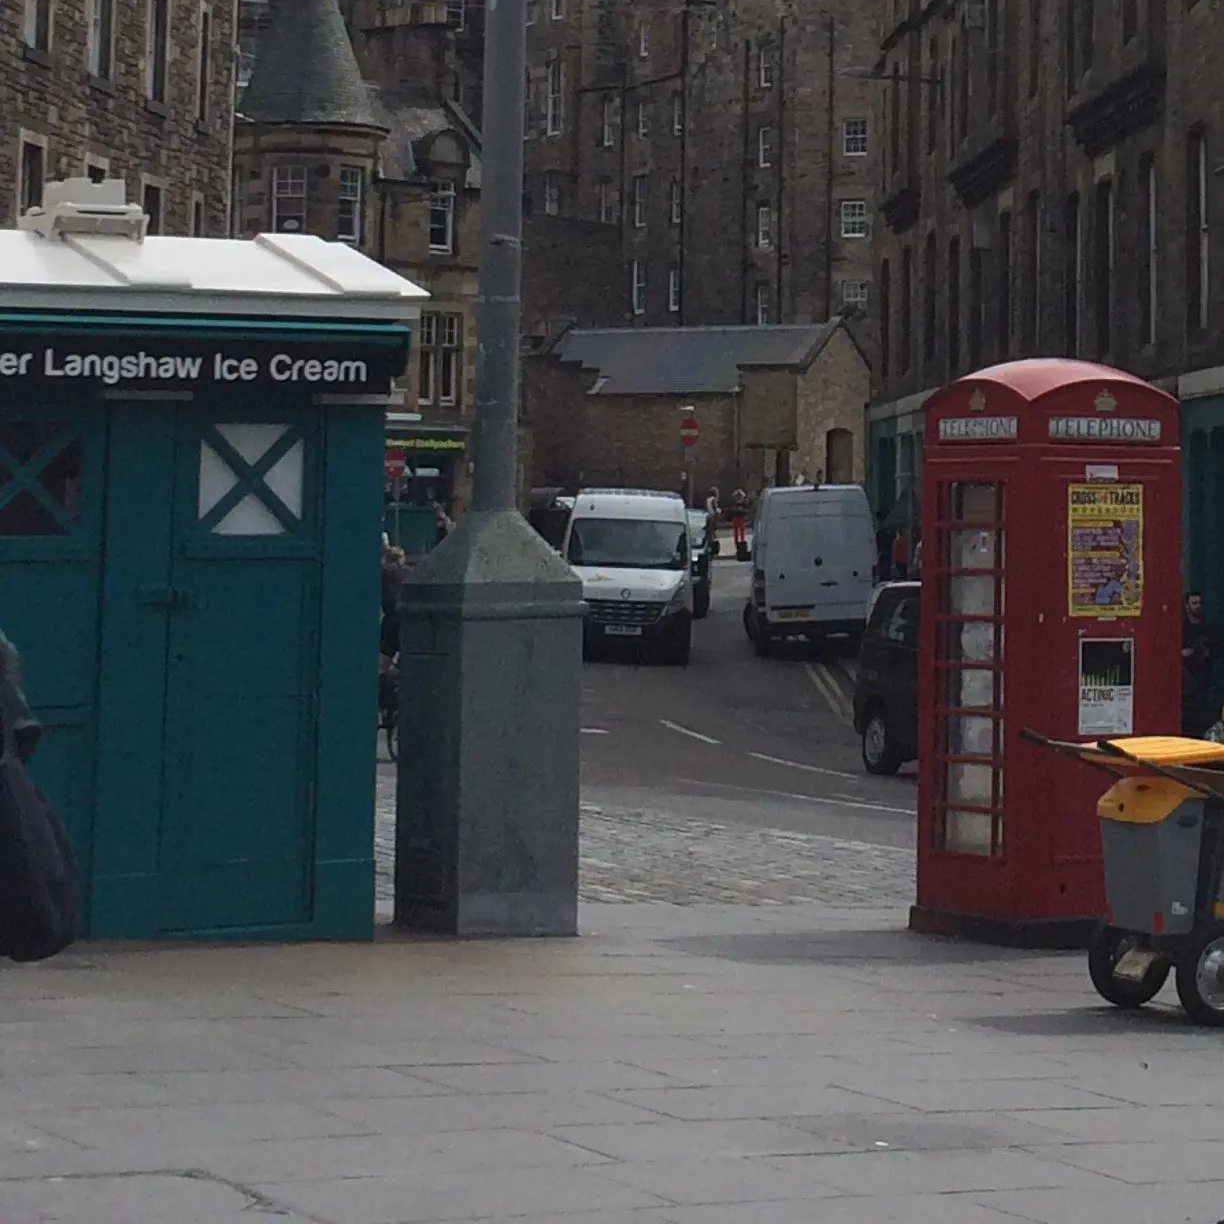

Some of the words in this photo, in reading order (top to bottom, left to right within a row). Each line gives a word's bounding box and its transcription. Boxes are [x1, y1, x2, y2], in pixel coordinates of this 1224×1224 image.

[44, 348, 203, 384] Langshaw
[213, 353, 259, 380] Ice
[269, 354, 368, 382] Cream
[941, 419, 1015, 437] TELEPHONE
[1052, 418, 1157, 439] TELEPHONE
